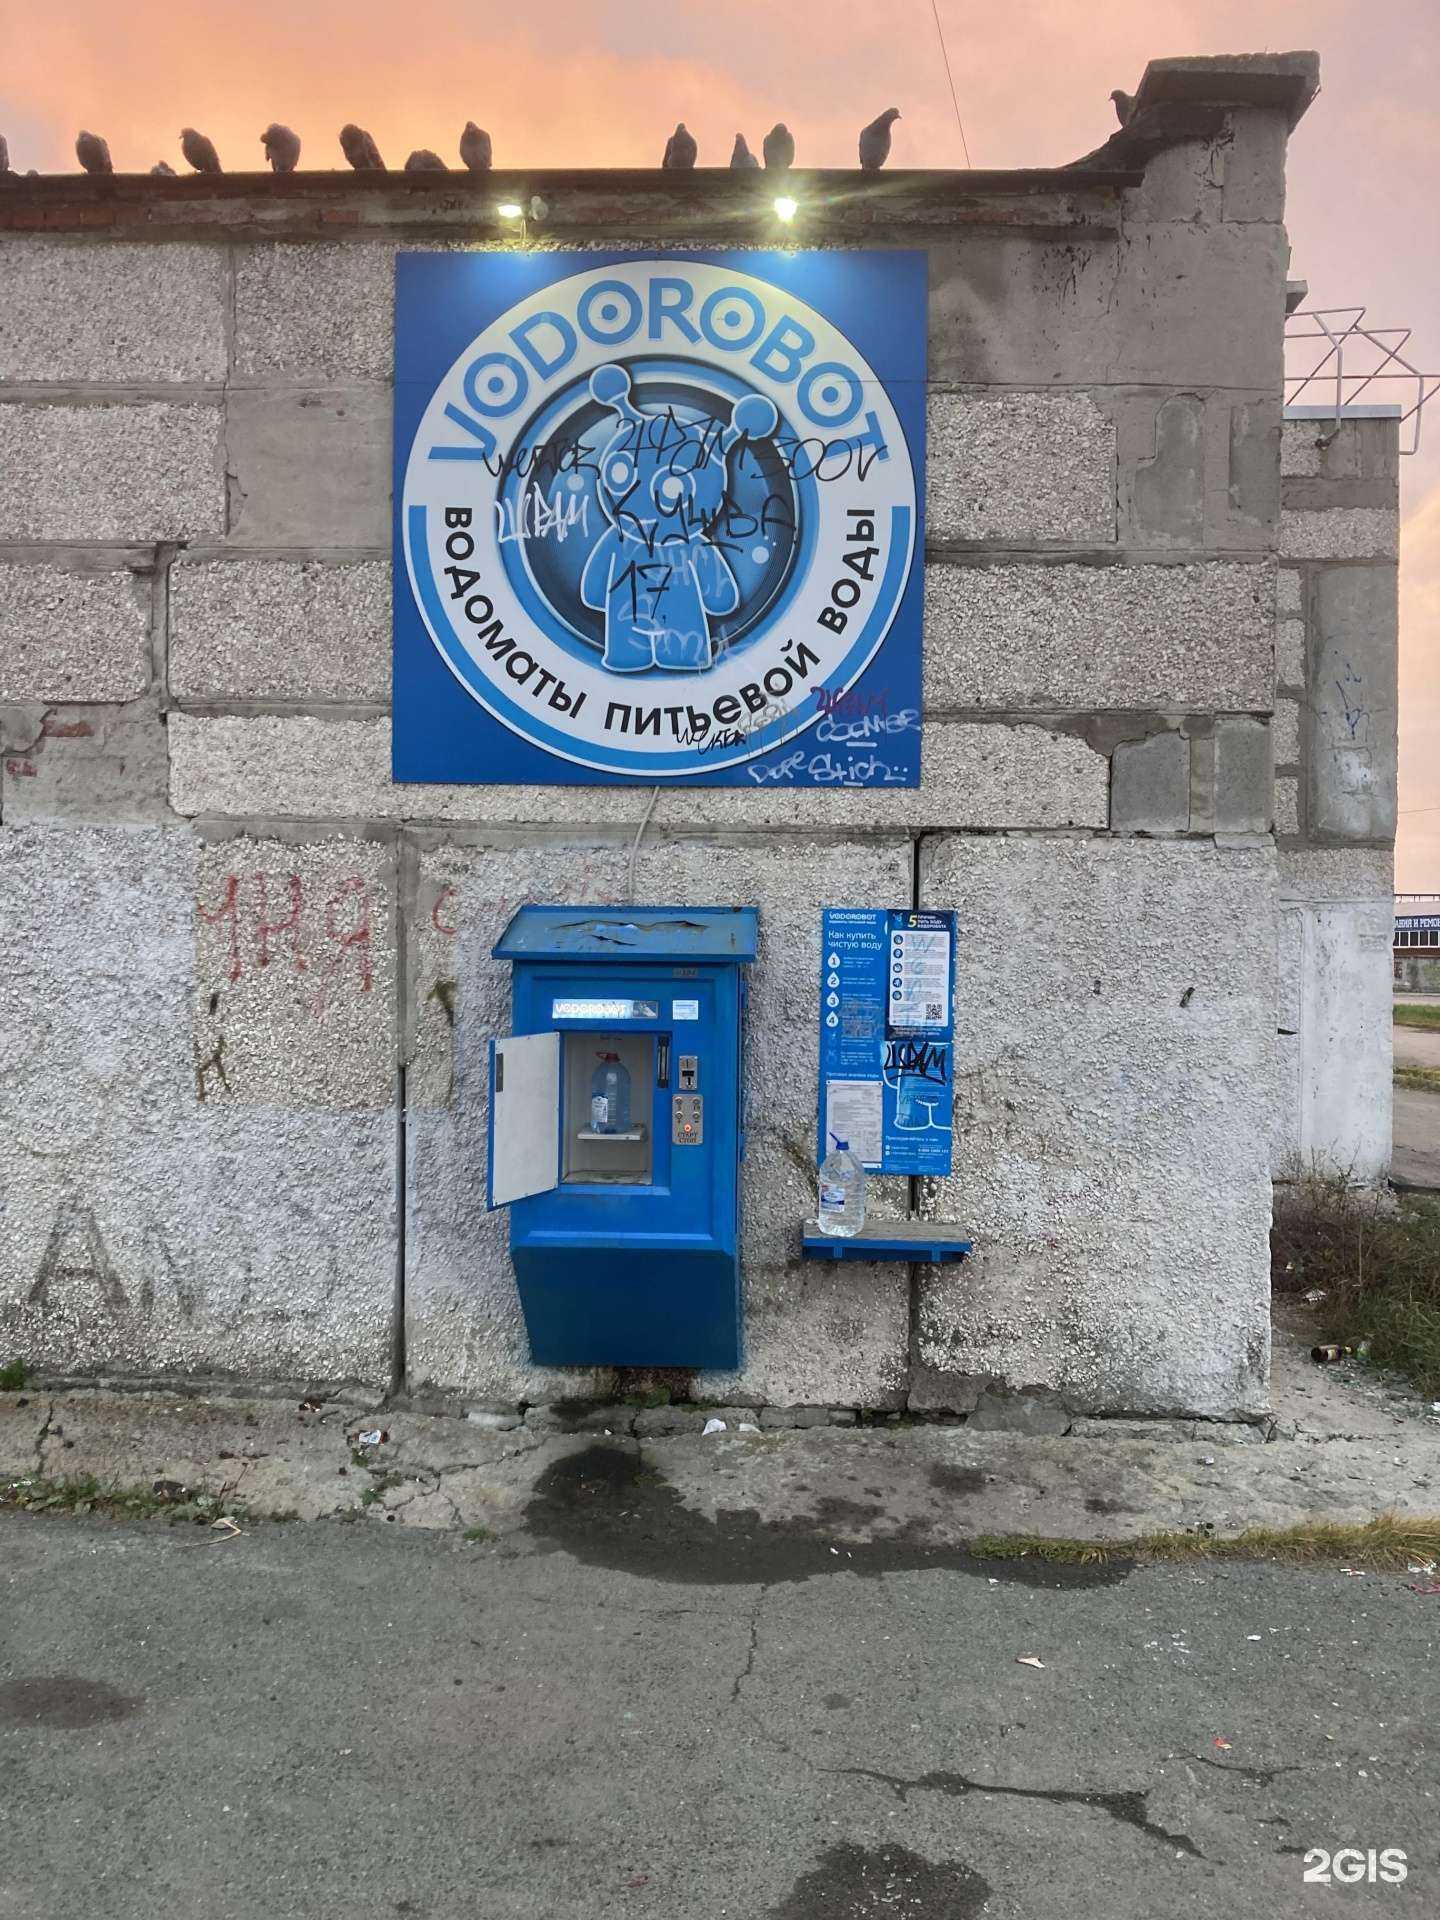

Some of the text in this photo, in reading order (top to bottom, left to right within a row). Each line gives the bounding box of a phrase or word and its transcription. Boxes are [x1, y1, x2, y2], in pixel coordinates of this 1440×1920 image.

[427, 276, 891, 465] VODOROBOT
[907, 914, 918, 928] 5
[828, 930, 877, 941] Как купить
[828, 941, 883, 951] чистую воду
[830, 977, 837, 985] 2
